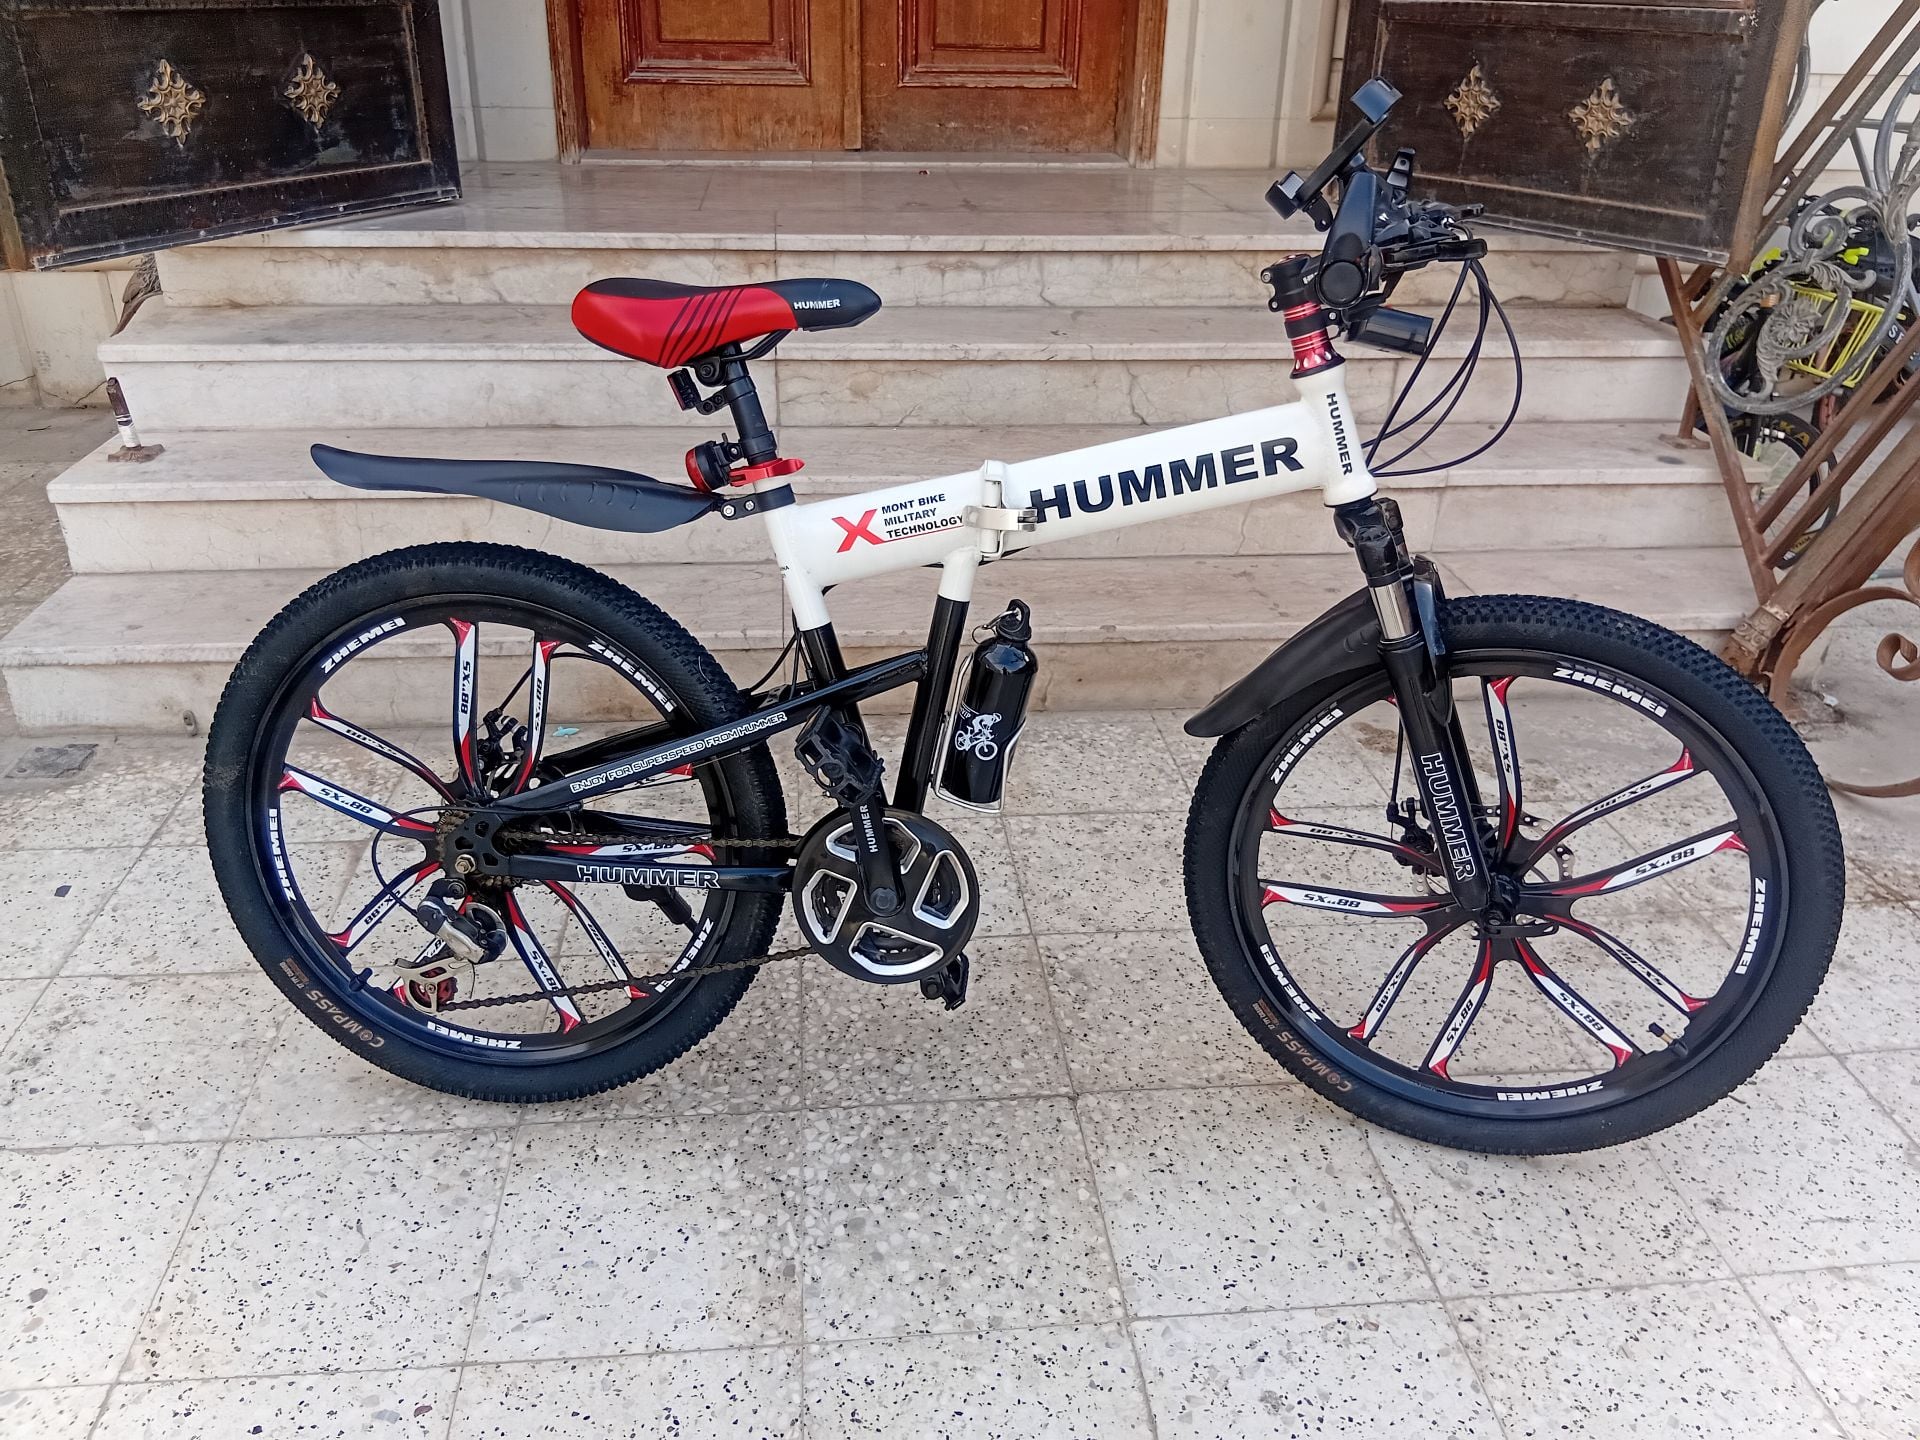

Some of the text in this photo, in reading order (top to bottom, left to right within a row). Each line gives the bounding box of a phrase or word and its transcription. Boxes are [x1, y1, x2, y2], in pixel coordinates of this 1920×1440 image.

[793, 298, 841, 310] HUMMER
[1326, 392, 1353, 476] HUMMER
[881, 493, 946, 515] MONT BIKE
[1029, 437, 1304, 524] HUMMER
[883, 508, 937, 527] MILITARY
[886, 514, 964, 539] TECHNOLOGY
[320, 617, 407, 674] ZHEMEI
[587, 640, 674, 713] ZHEMEI
[1553, 667, 1668, 718] ZHEMEI
[570, 774, 607, 794] ENJOY
[607, 764, 633, 782] FOR
[632, 741, 705, 772] SUPERSPEED
[704, 730, 740, 748] FROM
[737, 711, 788, 738] HUMMER
[1270, 708, 1344, 785] ZHEMEI
[859, 804, 879, 853] HUMMER
[1420, 752, 1476, 881] HUMMER
[269, 808, 297, 902] ZHEMEI
[576, 864, 721, 889] HUMMER
[1735, 877, 1767, 975] ZHEMEI
[1260, 943, 1322, 1023] ZHEMEI
[306, 990, 385, 1048] COMPASS
[427, 1021, 522, 1049] ZHEMEI
[1276, 1031, 1353, 1092] COMPASS
[1496, 1080, 1604, 1101] ZHEMEI
